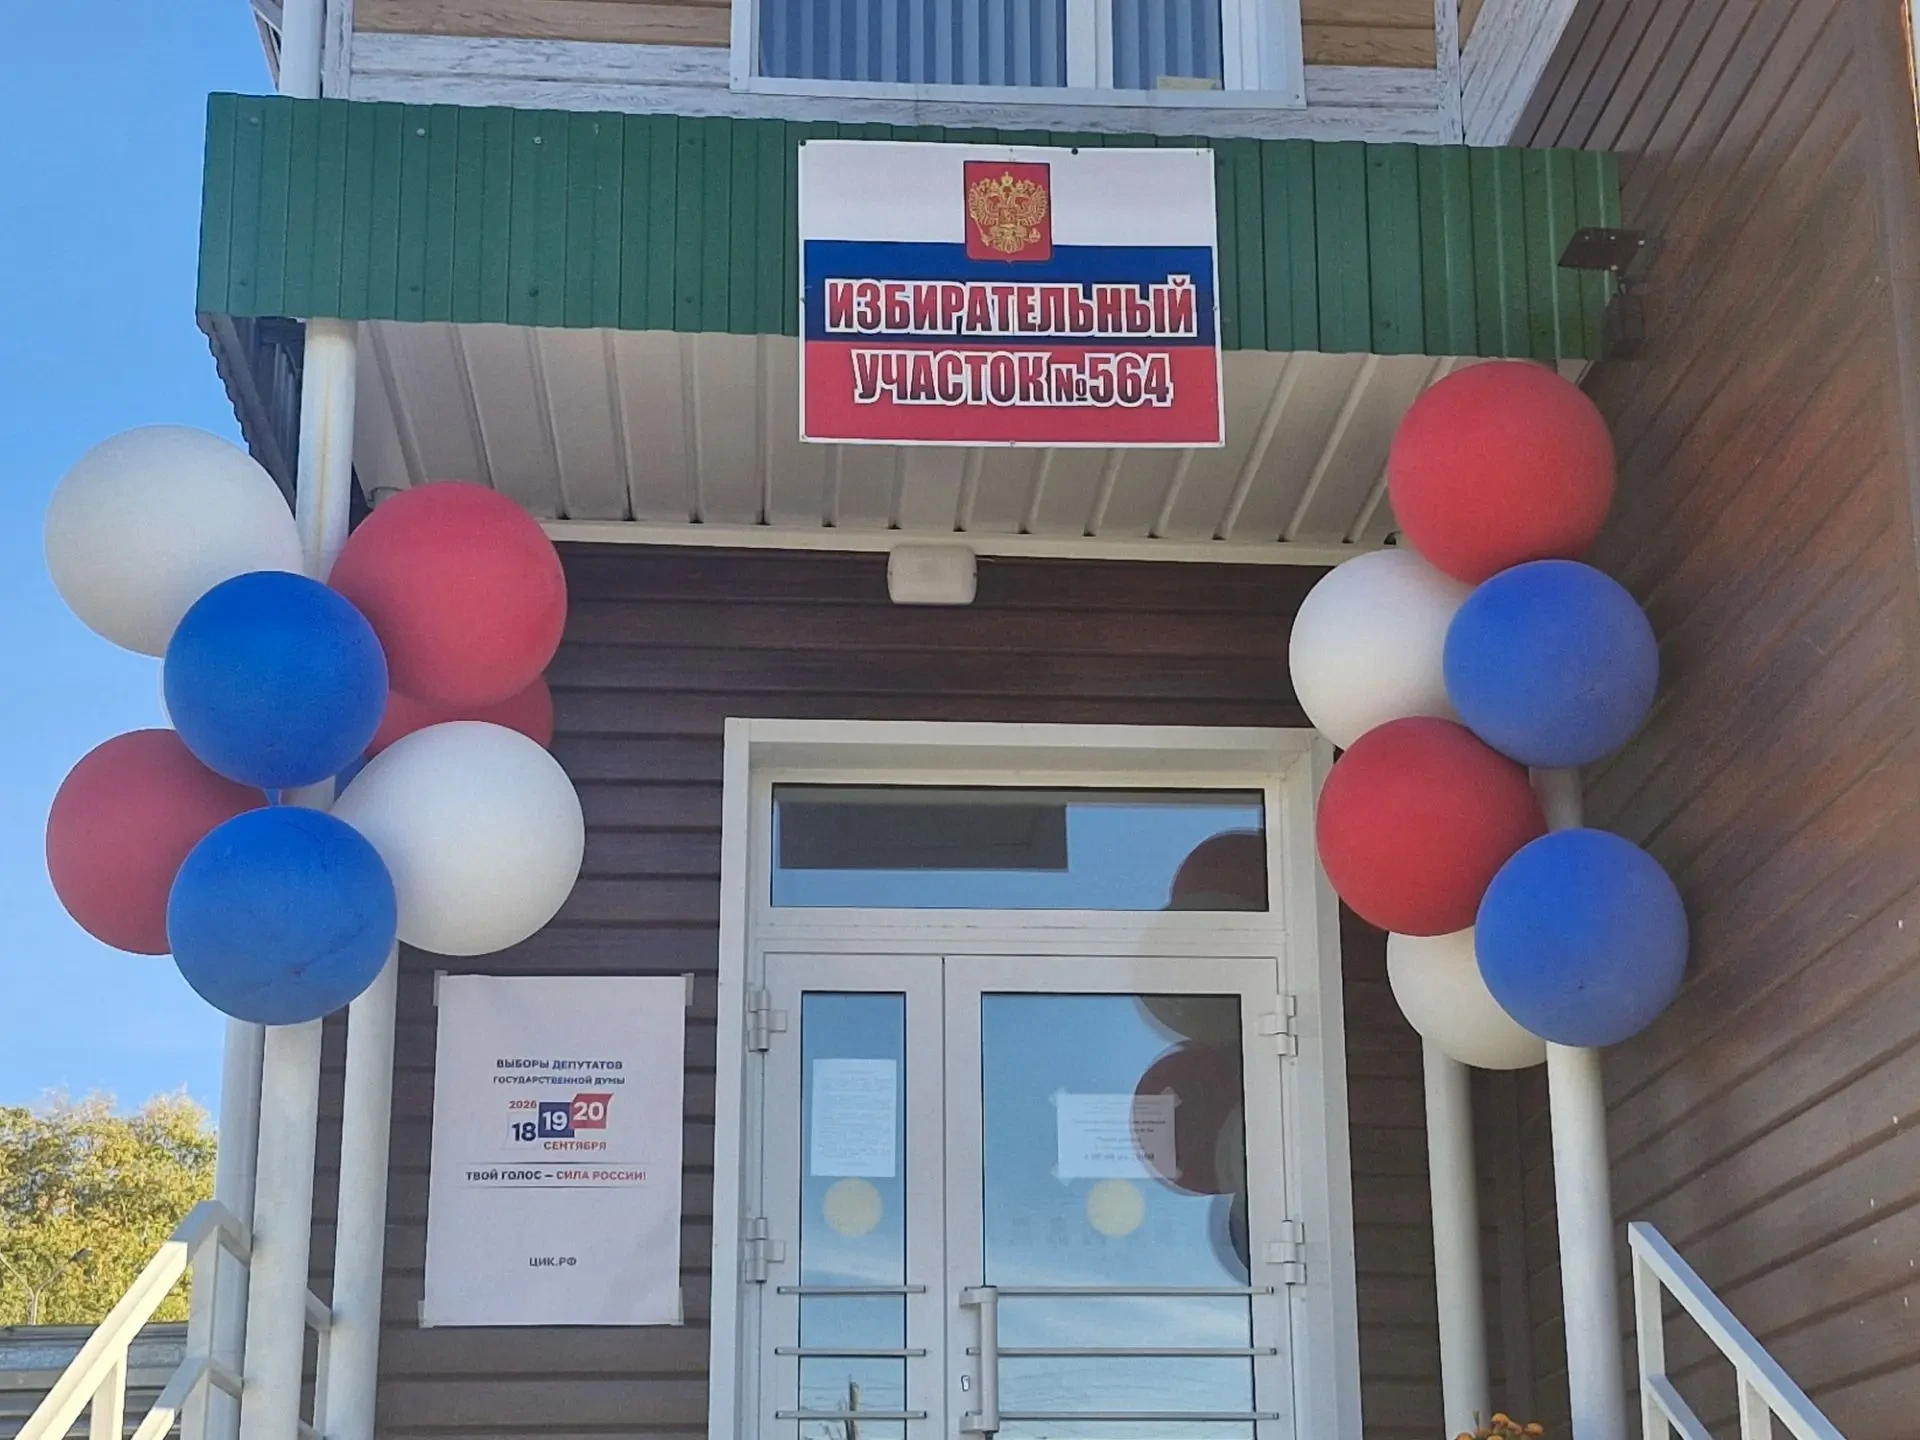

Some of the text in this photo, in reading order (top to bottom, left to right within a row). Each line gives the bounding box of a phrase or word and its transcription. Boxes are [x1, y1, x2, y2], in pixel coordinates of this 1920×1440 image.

[825, 275, 1195, 337] ИЗБИРАТЕЛЬНЫЙ
[496, 1059, 623, 1070] ВЫБОРЫ ДЕПУТАТОВ
[493, 1075, 625, 1086] ГОСУДАРСТВЕННОЙ ДУМЫ
[512, 1101, 604, 1141] 18 19 20
[543, 1141, 607, 1151] СЕНТЯБРЯ
[466, 1169, 498, 1181] ТВОЙ
[502, 1170, 542, 1180] ГОЛОС
[556, 1171, 590, 1180] СИЛА
[592, 1171, 646, 1181] РОССИИ!
[529, 1256, 577, 1267] ЦИК.РФ
